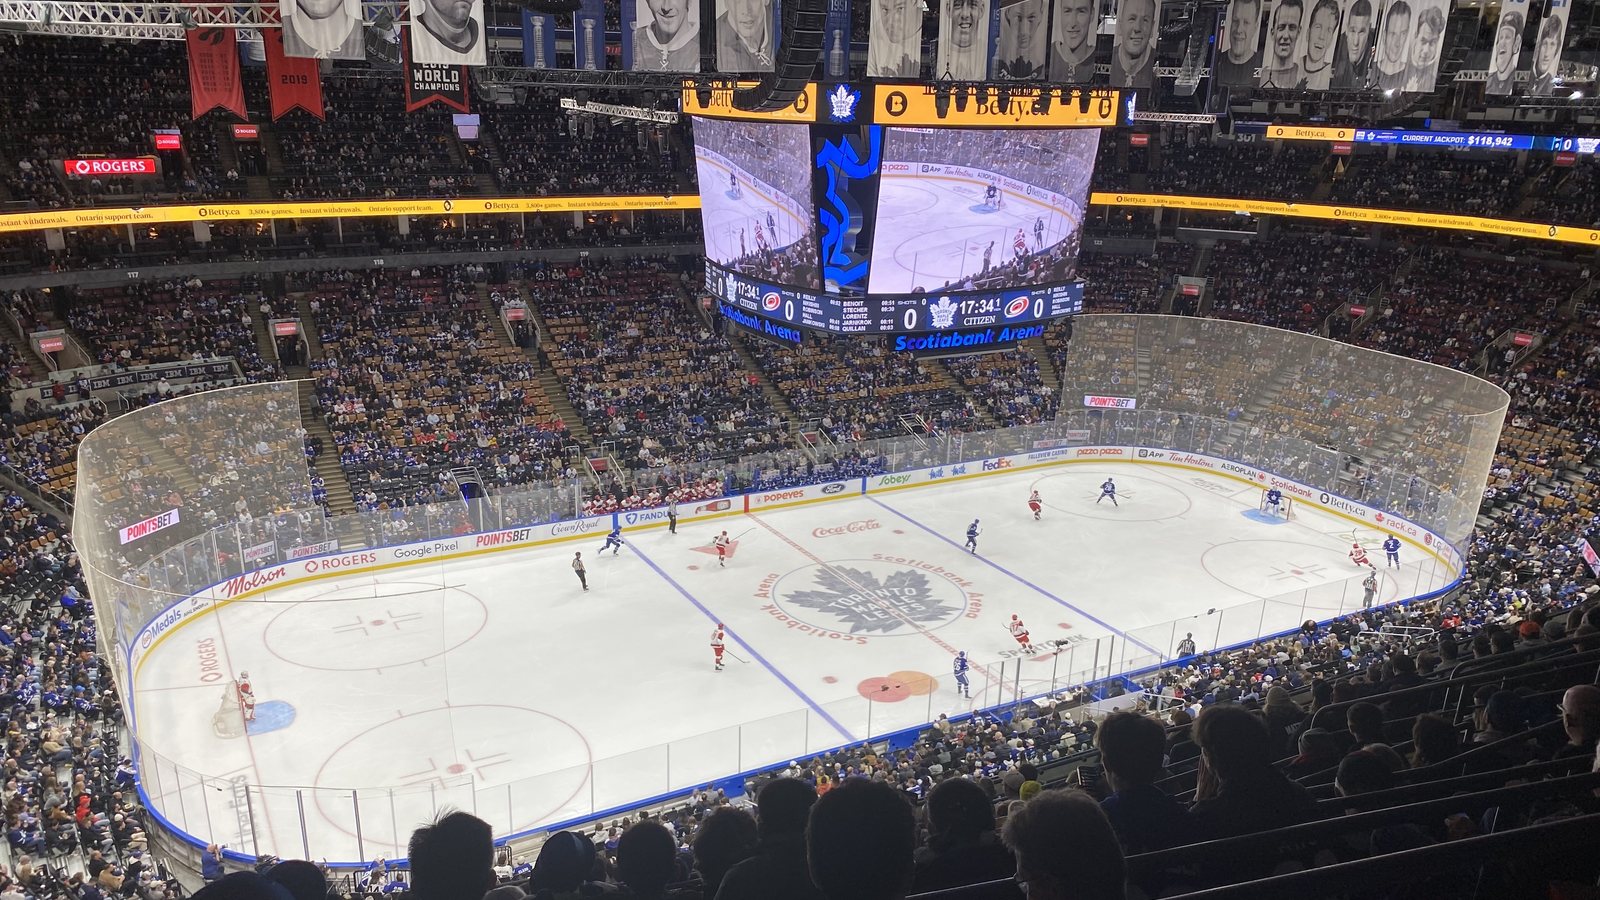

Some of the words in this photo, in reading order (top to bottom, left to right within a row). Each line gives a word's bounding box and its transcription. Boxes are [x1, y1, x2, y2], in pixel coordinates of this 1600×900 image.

[282, 74, 308, 84] 2019
[414, 70, 459, 82] WORLD
[415, 82, 460, 91] CHAMPIONS
[1296, 130, 1326, 138] Betty.ca
[1402, 134, 1433, 143] CURRENT
[1434, 136, 1466, 144] JACKPOT:
[1468, 136, 1512, 147] $118,942
[1564, 139, 1572, 150] 0
[93, 161, 146, 172] ROGERS
[208, 208, 240, 218] Betty.ca
[493, 202, 519, 210] Betty.ca
[24, 217, 68, 226] withdrawals.
[76, 214, 103, 222] Ontario
[104, 214, 131, 222] support
[740, 298, 758, 310] CITIZEN
[785, 300, 794, 320] 0
[1034, 298, 1043, 318] 0
[904, 309, 917, 330] 0
[964, 316, 995, 326] CITIZEN
[764, 320, 801, 343] Arena
[895, 328, 996, 351] Scotiabank
[998, 324, 1044, 342] Arena
[140, 371, 158, 380] IBM
[165, 368, 182, 377] IBM
[93, 380, 110, 388] IBM
[117, 376, 134, 384] IBM
[1090, 397, 1130, 407] POINTSBET
[1076, 449, 1098, 457] pizza
[1169, 452, 1183, 462] Tim
[1183, 454, 1214, 468] Hortons
[982, 458, 1012, 471] FedEx
[1221, 463, 1256, 477] AEROPLAN
[879, 474, 911, 486] Sobeys
[1271, 478, 1312, 498] Scotiabank
[1330, 496, 1366, 516] Betty.ca
[127, 512, 172, 540] POINTSBET
[551, 523, 575, 536] Crown
[574, 519, 600, 534] Royal
[1387, 518, 1417, 536] rack.ca
[476, 529, 531, 547] POINTSBET
[246, 545, 273, 558] POINTSBET
[292, 542, 332, 557] POINTSBET
[394, 545, 431, 558] Google
[435, 540, 459, 552] Pixel
[322, 552, 377, 570] ROGERS
[221, 568, 286, 598] Molson
[754, 573, 780, 599] Arena
[872, 552, 973, 588] Scotiabank
[966, 592, 984, 619] Arena
[151, 609, 182, 638] Medals
[760, 603, 868, 645] Scotiabank
[196, 637, 220, 672] ROGERS
